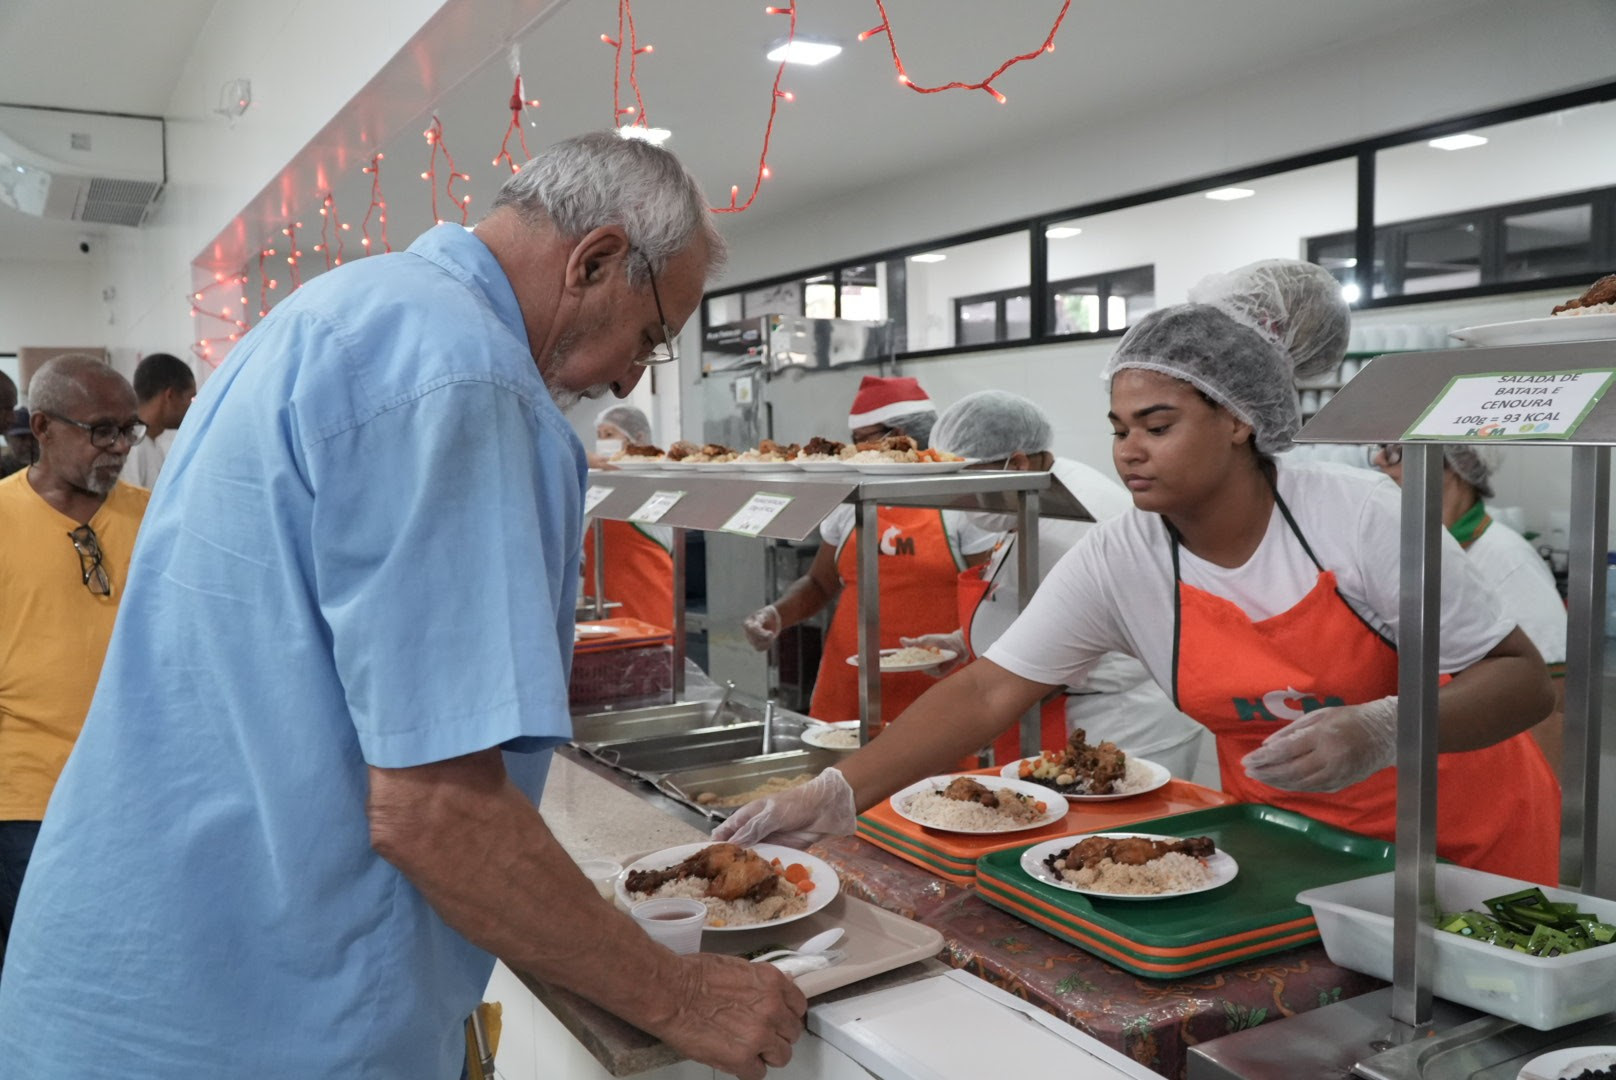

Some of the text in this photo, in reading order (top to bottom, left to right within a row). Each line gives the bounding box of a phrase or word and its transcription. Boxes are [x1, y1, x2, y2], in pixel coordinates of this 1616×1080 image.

[1498, 373, 1581, 384] SALADA DE
[1495, 386, 1563, 396] BATATA E
[1481, 398, 1553, 410] CENOURA
[1453, 416, 1488, 425] 100g
[1501, 414, 1521, 423] 93
[1523, 412, 1560, 422] KCAL
[1465, 423, 1506, 436] HCM
[877, 525, 915, 556] CM
